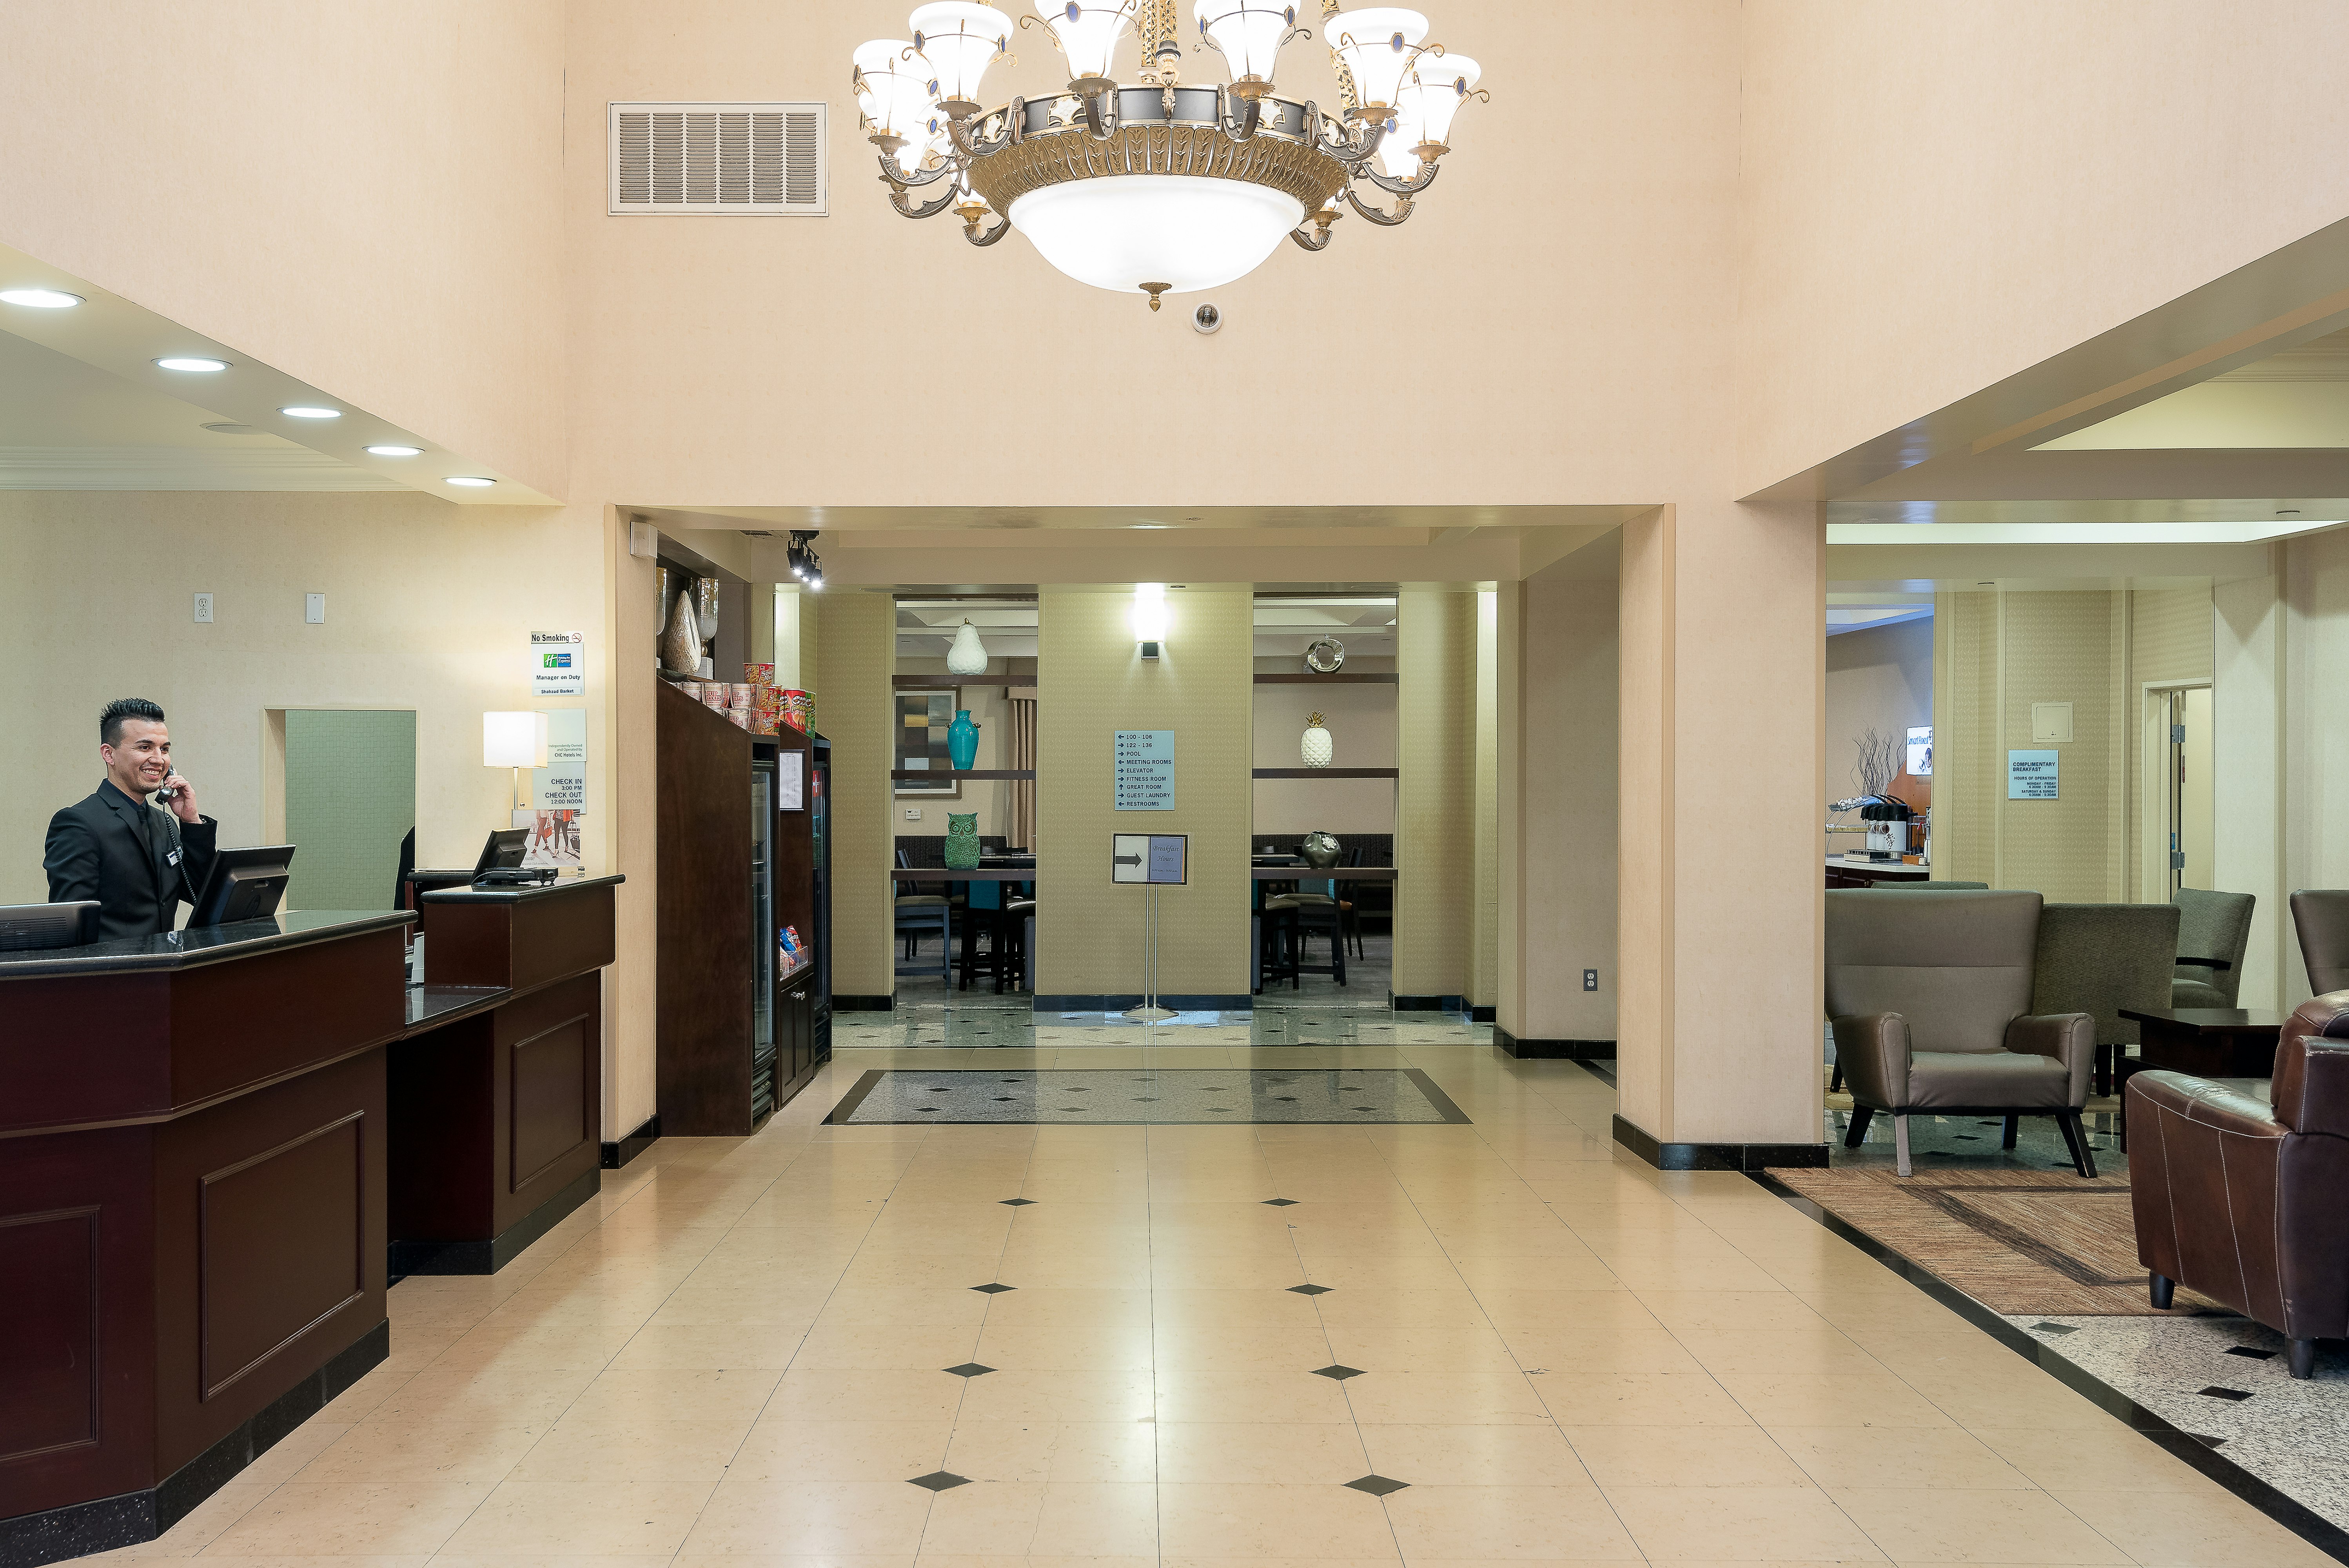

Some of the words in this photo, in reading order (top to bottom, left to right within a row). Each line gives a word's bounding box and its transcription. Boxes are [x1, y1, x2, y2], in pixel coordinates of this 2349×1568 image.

[542, 634, 569, 643] Smoking
[1908, 736, 1918, 745] Smart
[1919, 736, 1929, 744] Roast
